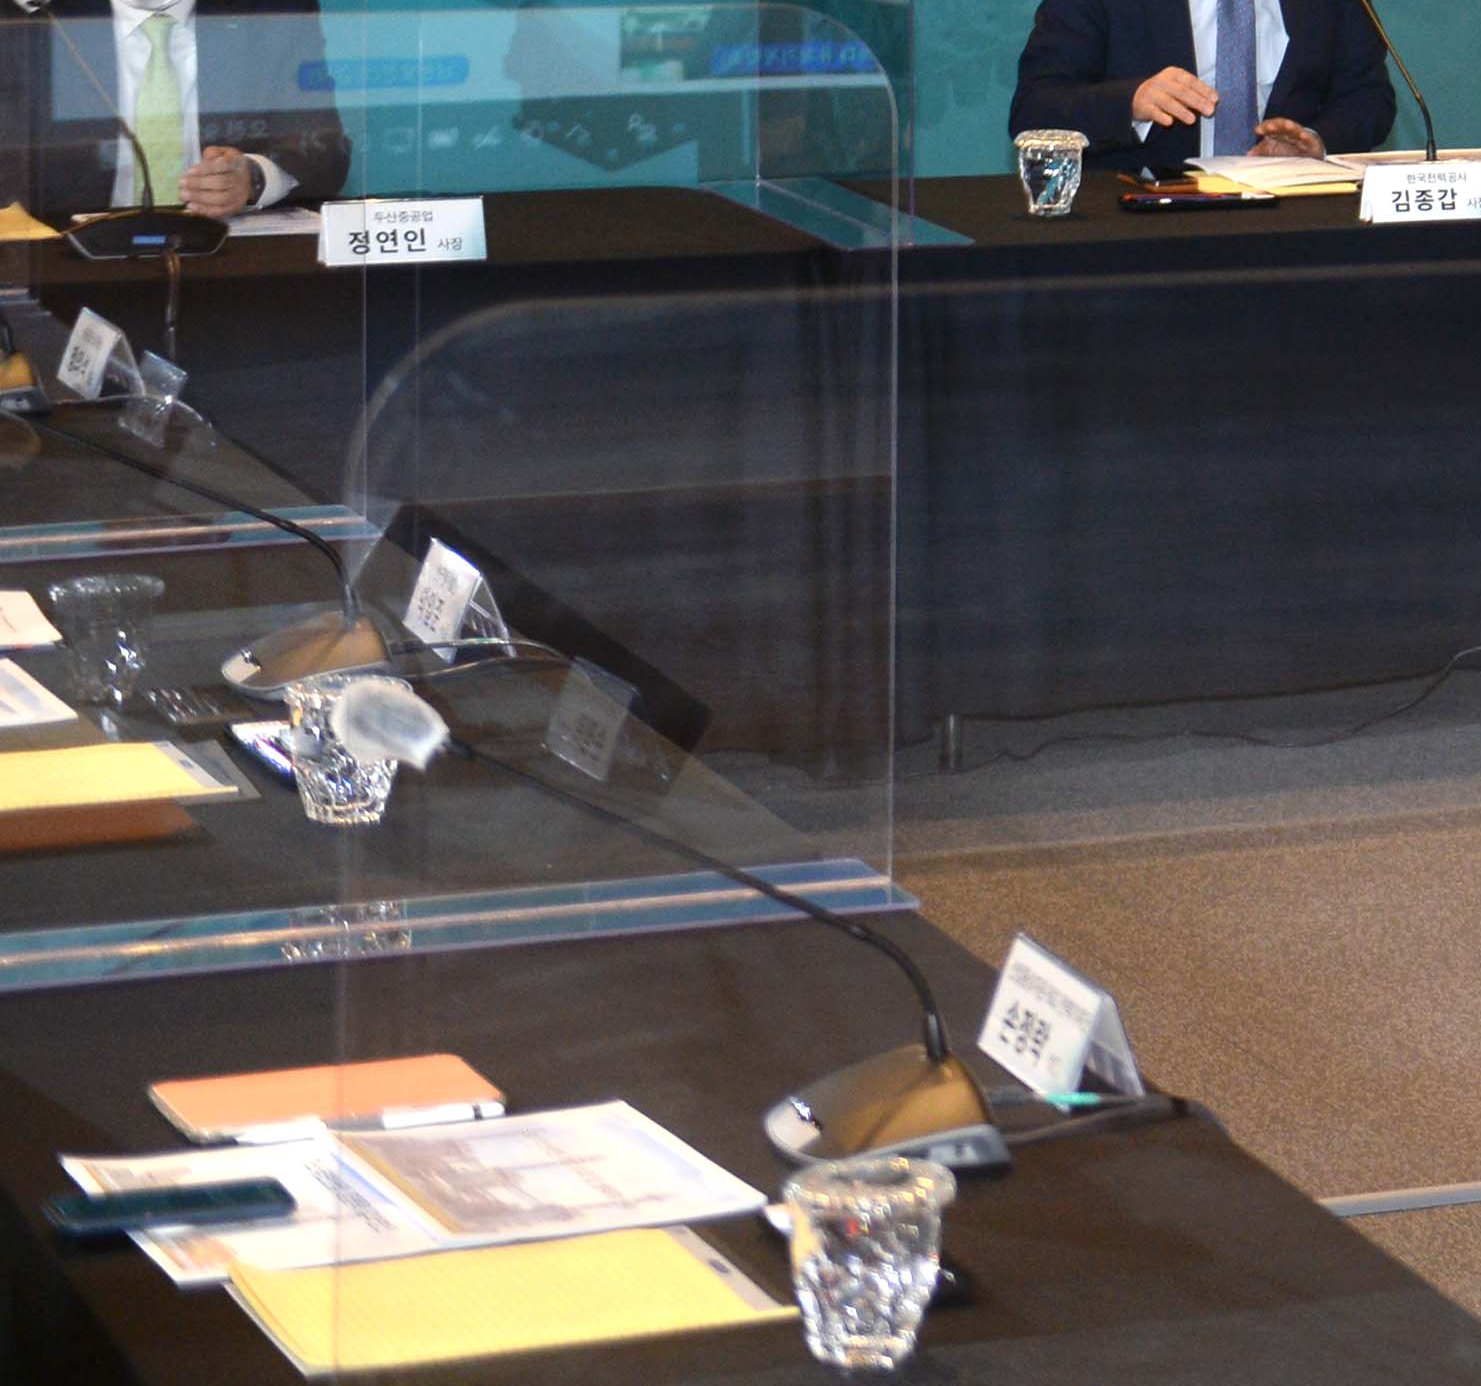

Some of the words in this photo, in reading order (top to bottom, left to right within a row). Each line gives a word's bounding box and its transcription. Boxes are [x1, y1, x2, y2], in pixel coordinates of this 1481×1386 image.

[1406, 171, 1467, 184] 한국전력공사
[1391, 188, 1457, 213] 김종갑
[373, 210, 434, 223] 두산중공업
[348, 228, 427, 255] 정연인
[437, 237, 463, 251] 사장
